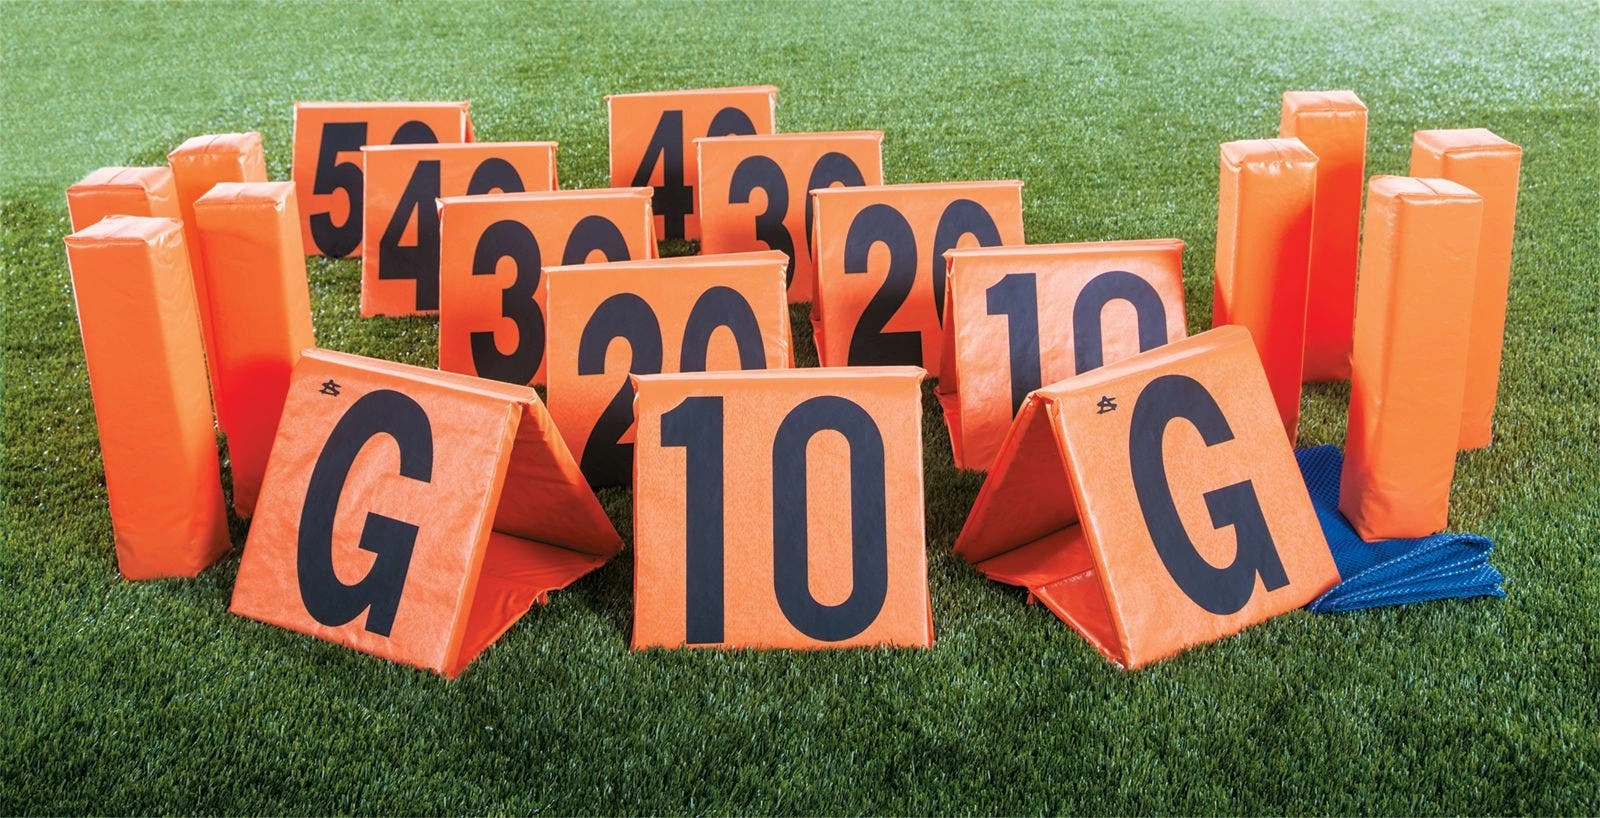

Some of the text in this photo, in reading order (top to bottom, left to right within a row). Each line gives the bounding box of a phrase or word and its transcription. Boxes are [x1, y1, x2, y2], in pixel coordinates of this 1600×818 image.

[310, 121, 438, 258] 5
[379, 157, 524, 311] 4
[631, 107, 756, 240] 4
[297, 389, 433, 636] G
[661, 395, 888, 644] 10
[1129, 374, 1289, 615] G
